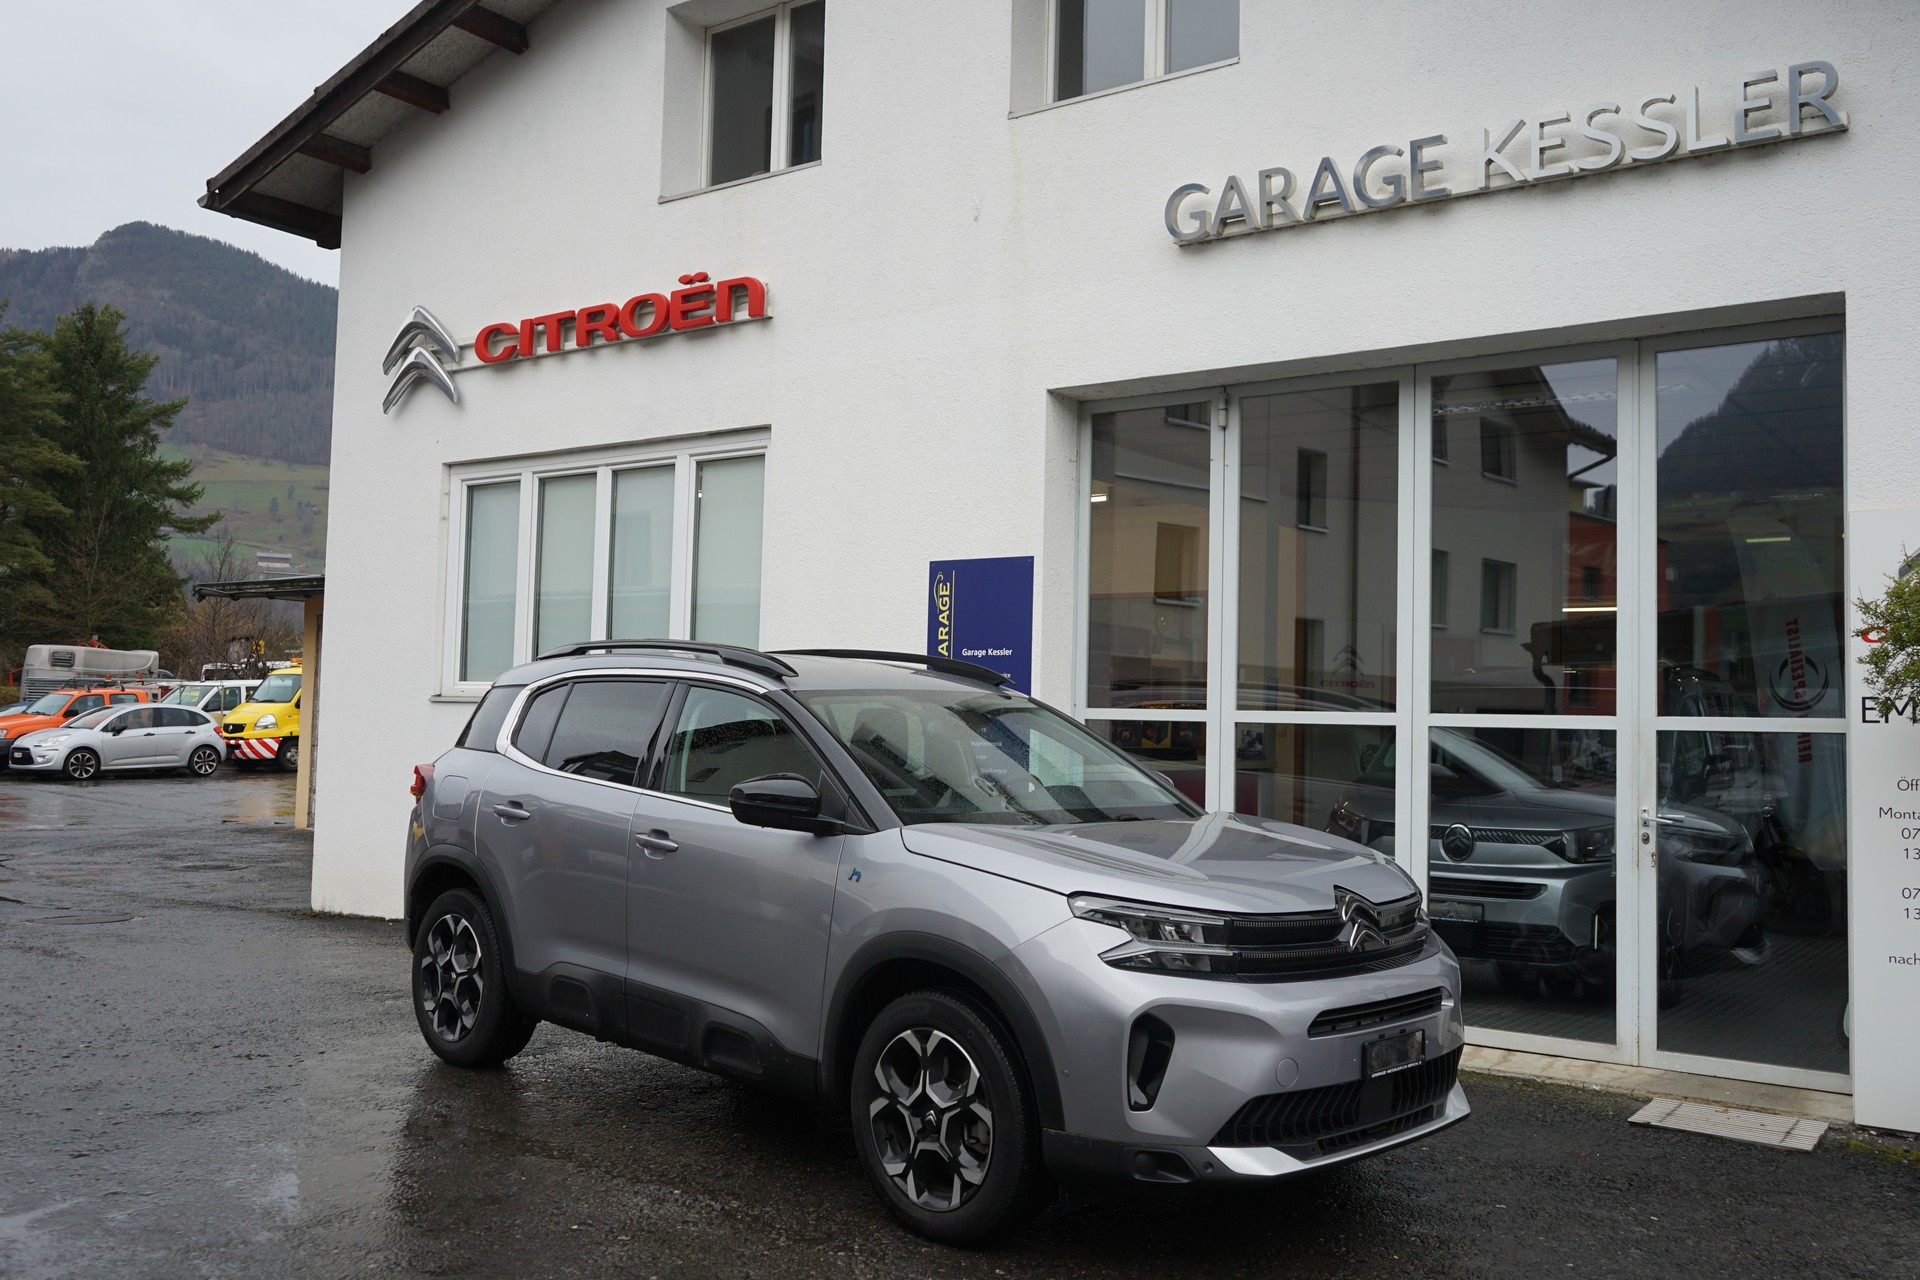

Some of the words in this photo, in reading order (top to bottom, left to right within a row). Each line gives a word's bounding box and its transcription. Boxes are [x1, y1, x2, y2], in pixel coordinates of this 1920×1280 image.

[1164, 133, 1452, 241] GARAGE
[1476, 60, 1845, 190] KESSLER
[937, 582, 950, 659] ARAGE
[962, 648, 987, 658] Garage
[988, 647, 1013, 656] Kessler
[1879, 806, 1920, 820] Mont
